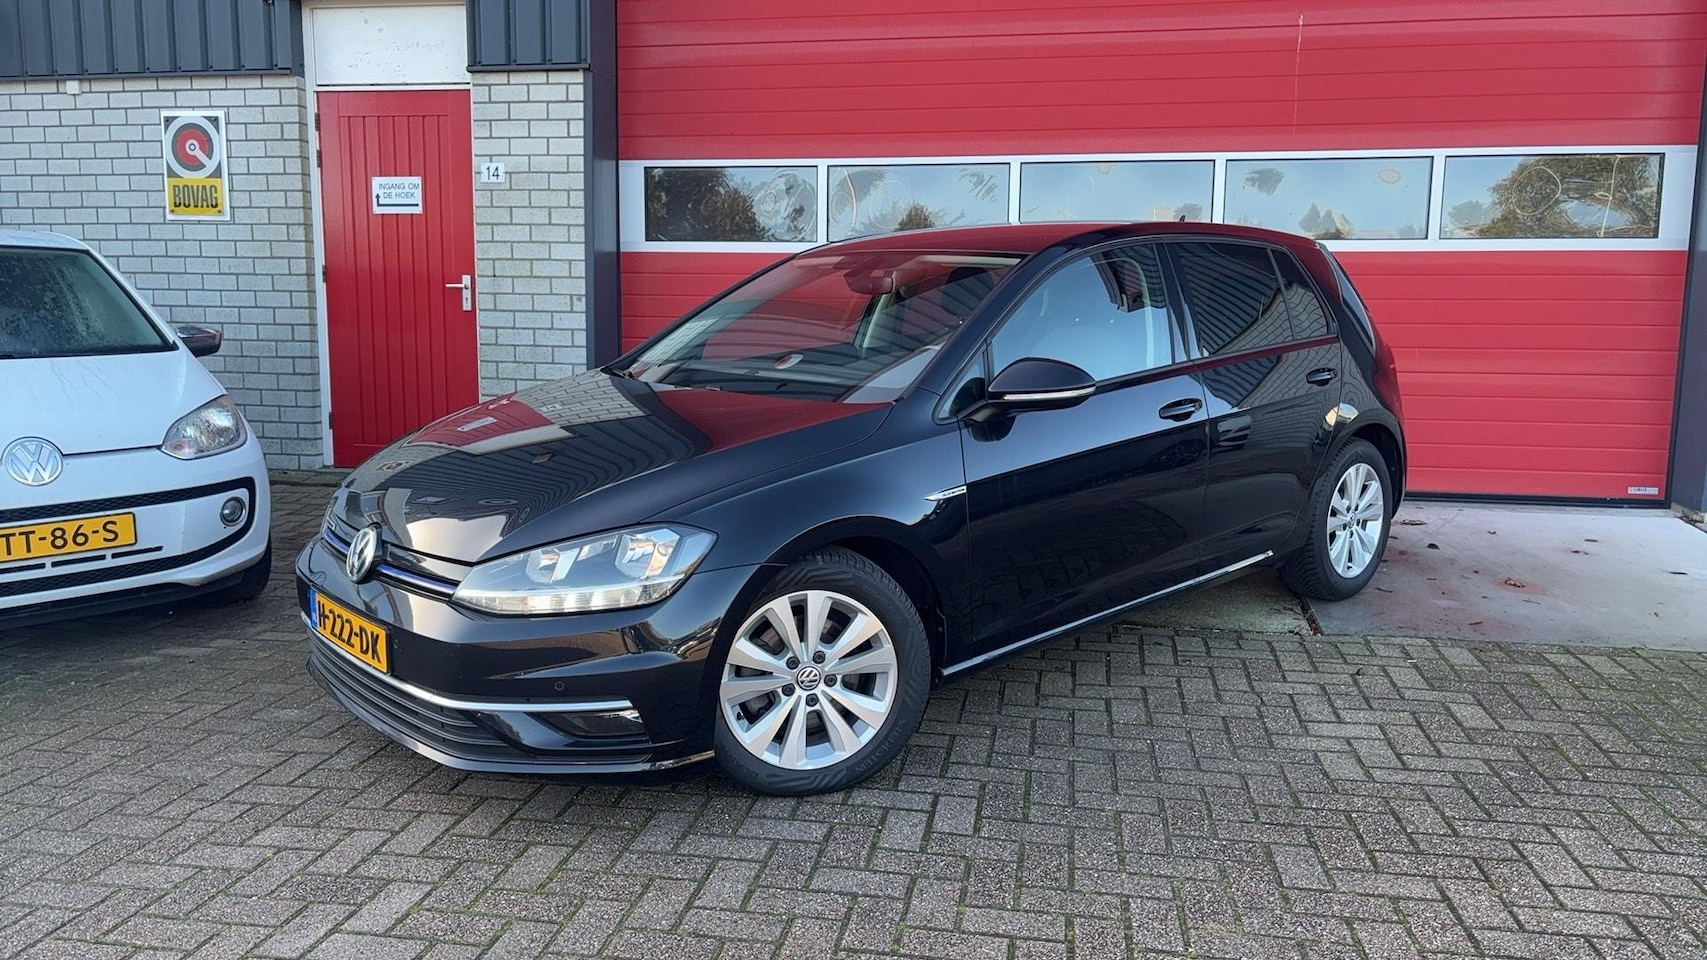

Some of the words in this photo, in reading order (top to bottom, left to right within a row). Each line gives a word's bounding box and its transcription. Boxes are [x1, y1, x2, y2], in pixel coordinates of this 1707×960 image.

[486, 166, 500, 180] 14
[172, 184, 219, 209] BOVAG
[0, 520, 119, 556] TT-86-S
[317, 600, 382, 664] H-222-DK
